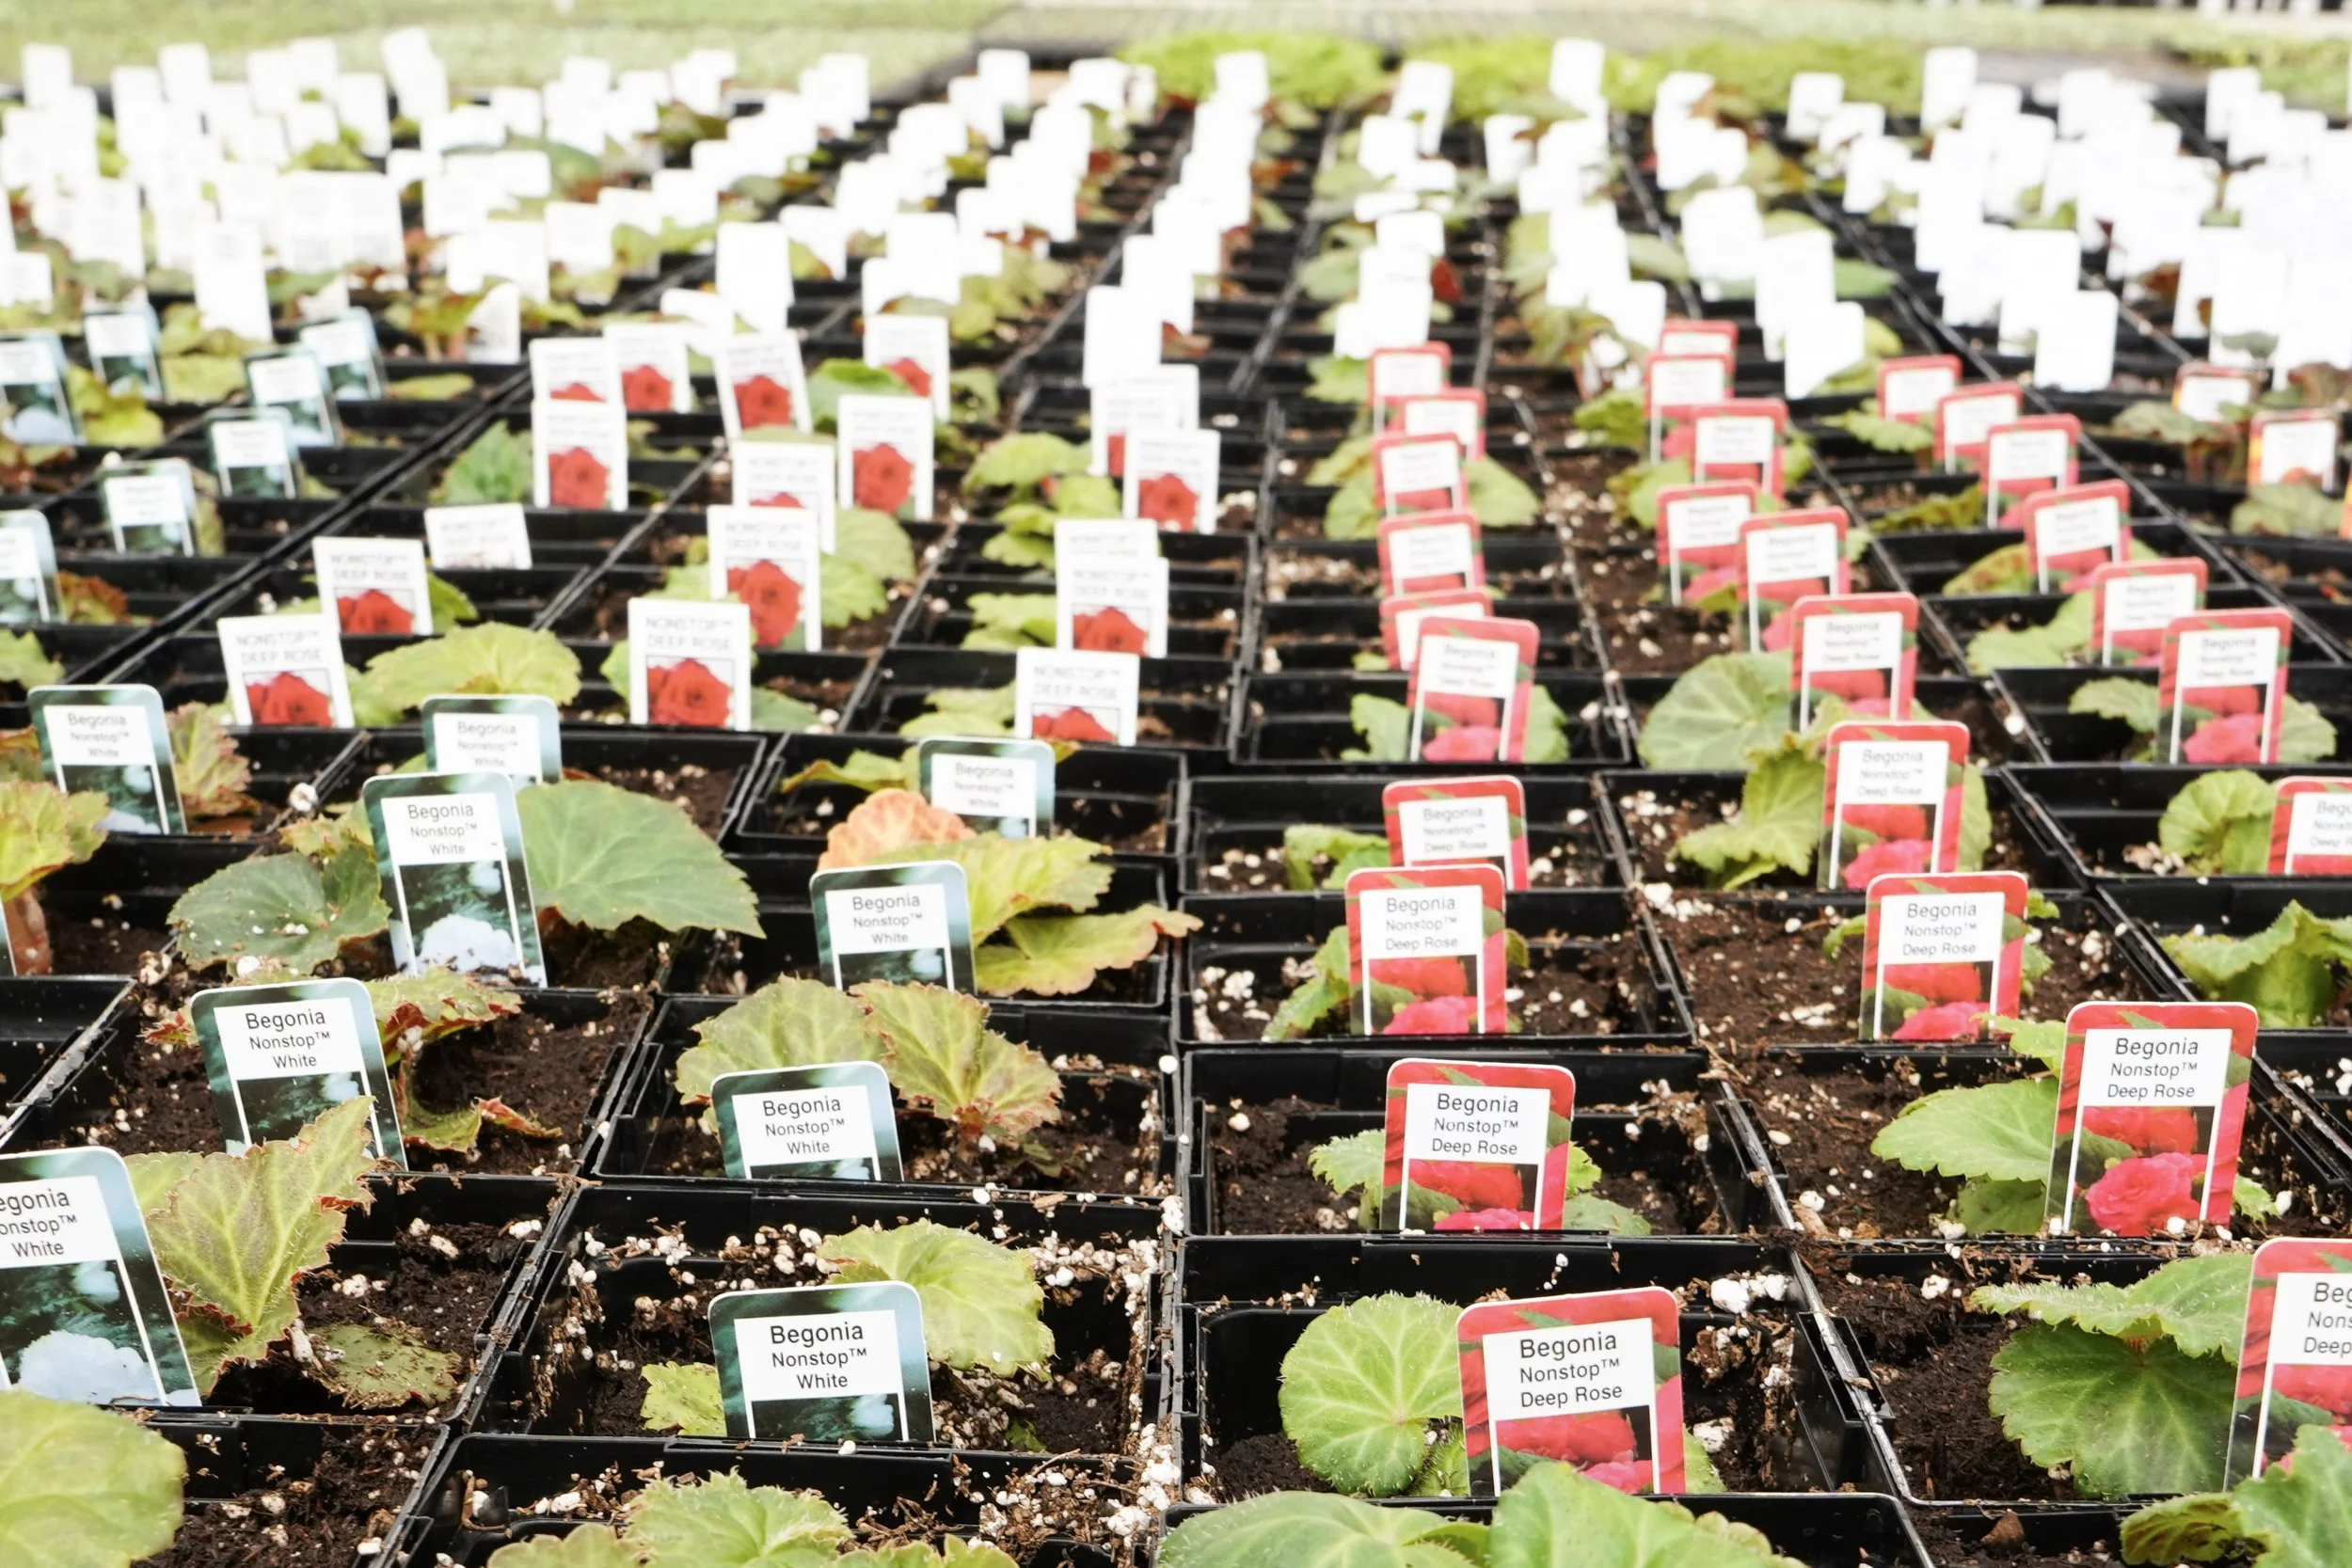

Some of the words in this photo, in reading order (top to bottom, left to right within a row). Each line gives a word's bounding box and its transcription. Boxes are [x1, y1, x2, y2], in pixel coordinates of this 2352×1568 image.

[68, 712, 127, 729] Begonia
[457, 721, 516, 737] Begonia
[71, 731, 130, 744] Nonstop™
[88, 747, 119, 759] White
[1862, 749, 1923, 766] Begonia
[474, 758, 505, 767] White
[955, 763, 1014, 780] Begonia
[1858, 786, 1887, 798] Deep
[1892, 785, 1922, 796] Rose
[407, 801, 474, 822] Begonia
[968, 798, 1000, 809] White
[1422, 806, 1484, 823] Begonia
[410, 822, 477, 838] Nonstop™
[429, 844, 466, 856] White
[1423, 842, 1454, 853] Deep
[1459, 840, 1487, 851] Rose
[851, 894, 920, 913] Begonia
[1386, 896, 1455, 915] Begonia
[1907, 901, 1977, 922] Begonia
[853, 912, 923, 928] Nonstop™
[1386, 916, 1457, 932] Nonstop™
[871, 932, 909, 945] White
[1904, 924, 1977, 938] Nonstop™
[1385, 938, 1420, 951] Deep
[1424, 936, 1458, 949] Rose
[1902, 943, 1937, 957] Deep
[1942, 942, 1976, 955] Rose
[245, 1009, 326, 1031] Begonia
[249, 1031, 330, 1052] Nonstop™
[2115, 1037, 2199, 1060] Begonia
[272, 1053, 317, 1069] White
[2110, 1063, 2198, 1080] Nonstop™
[2107, 1084, 2148, 1101] Deep
[2154, 1084, 2195, 1099] Rose
[762, 1095, 841, 1118] Begonia
[1437, 1093, 1518, 1117] Begonia
[765, 1117, 845, 1137] Nonstop™
[1434, 1118, 1518, 1136] Nonstop™
[787, 1141, 830, 1155] White
[1431, 1138, 1471, 1156] Deep
[1477, 1140, 1518, 1156] Rose
[12, 1240, 65, 1258] White
[770, 1322, 864, 1348] Begonia
[1519, 1331, 1617, 1362] Begonia
[771, 1347, 867, 1368] Nonstop™
[1519, 1357, 1620, 1384] Nonstop™
[796, 1373, 849, 1389] White
[1520, 1390, 1568, 1409] Deep
[1575, 1384, 1623, 1402] Rose
